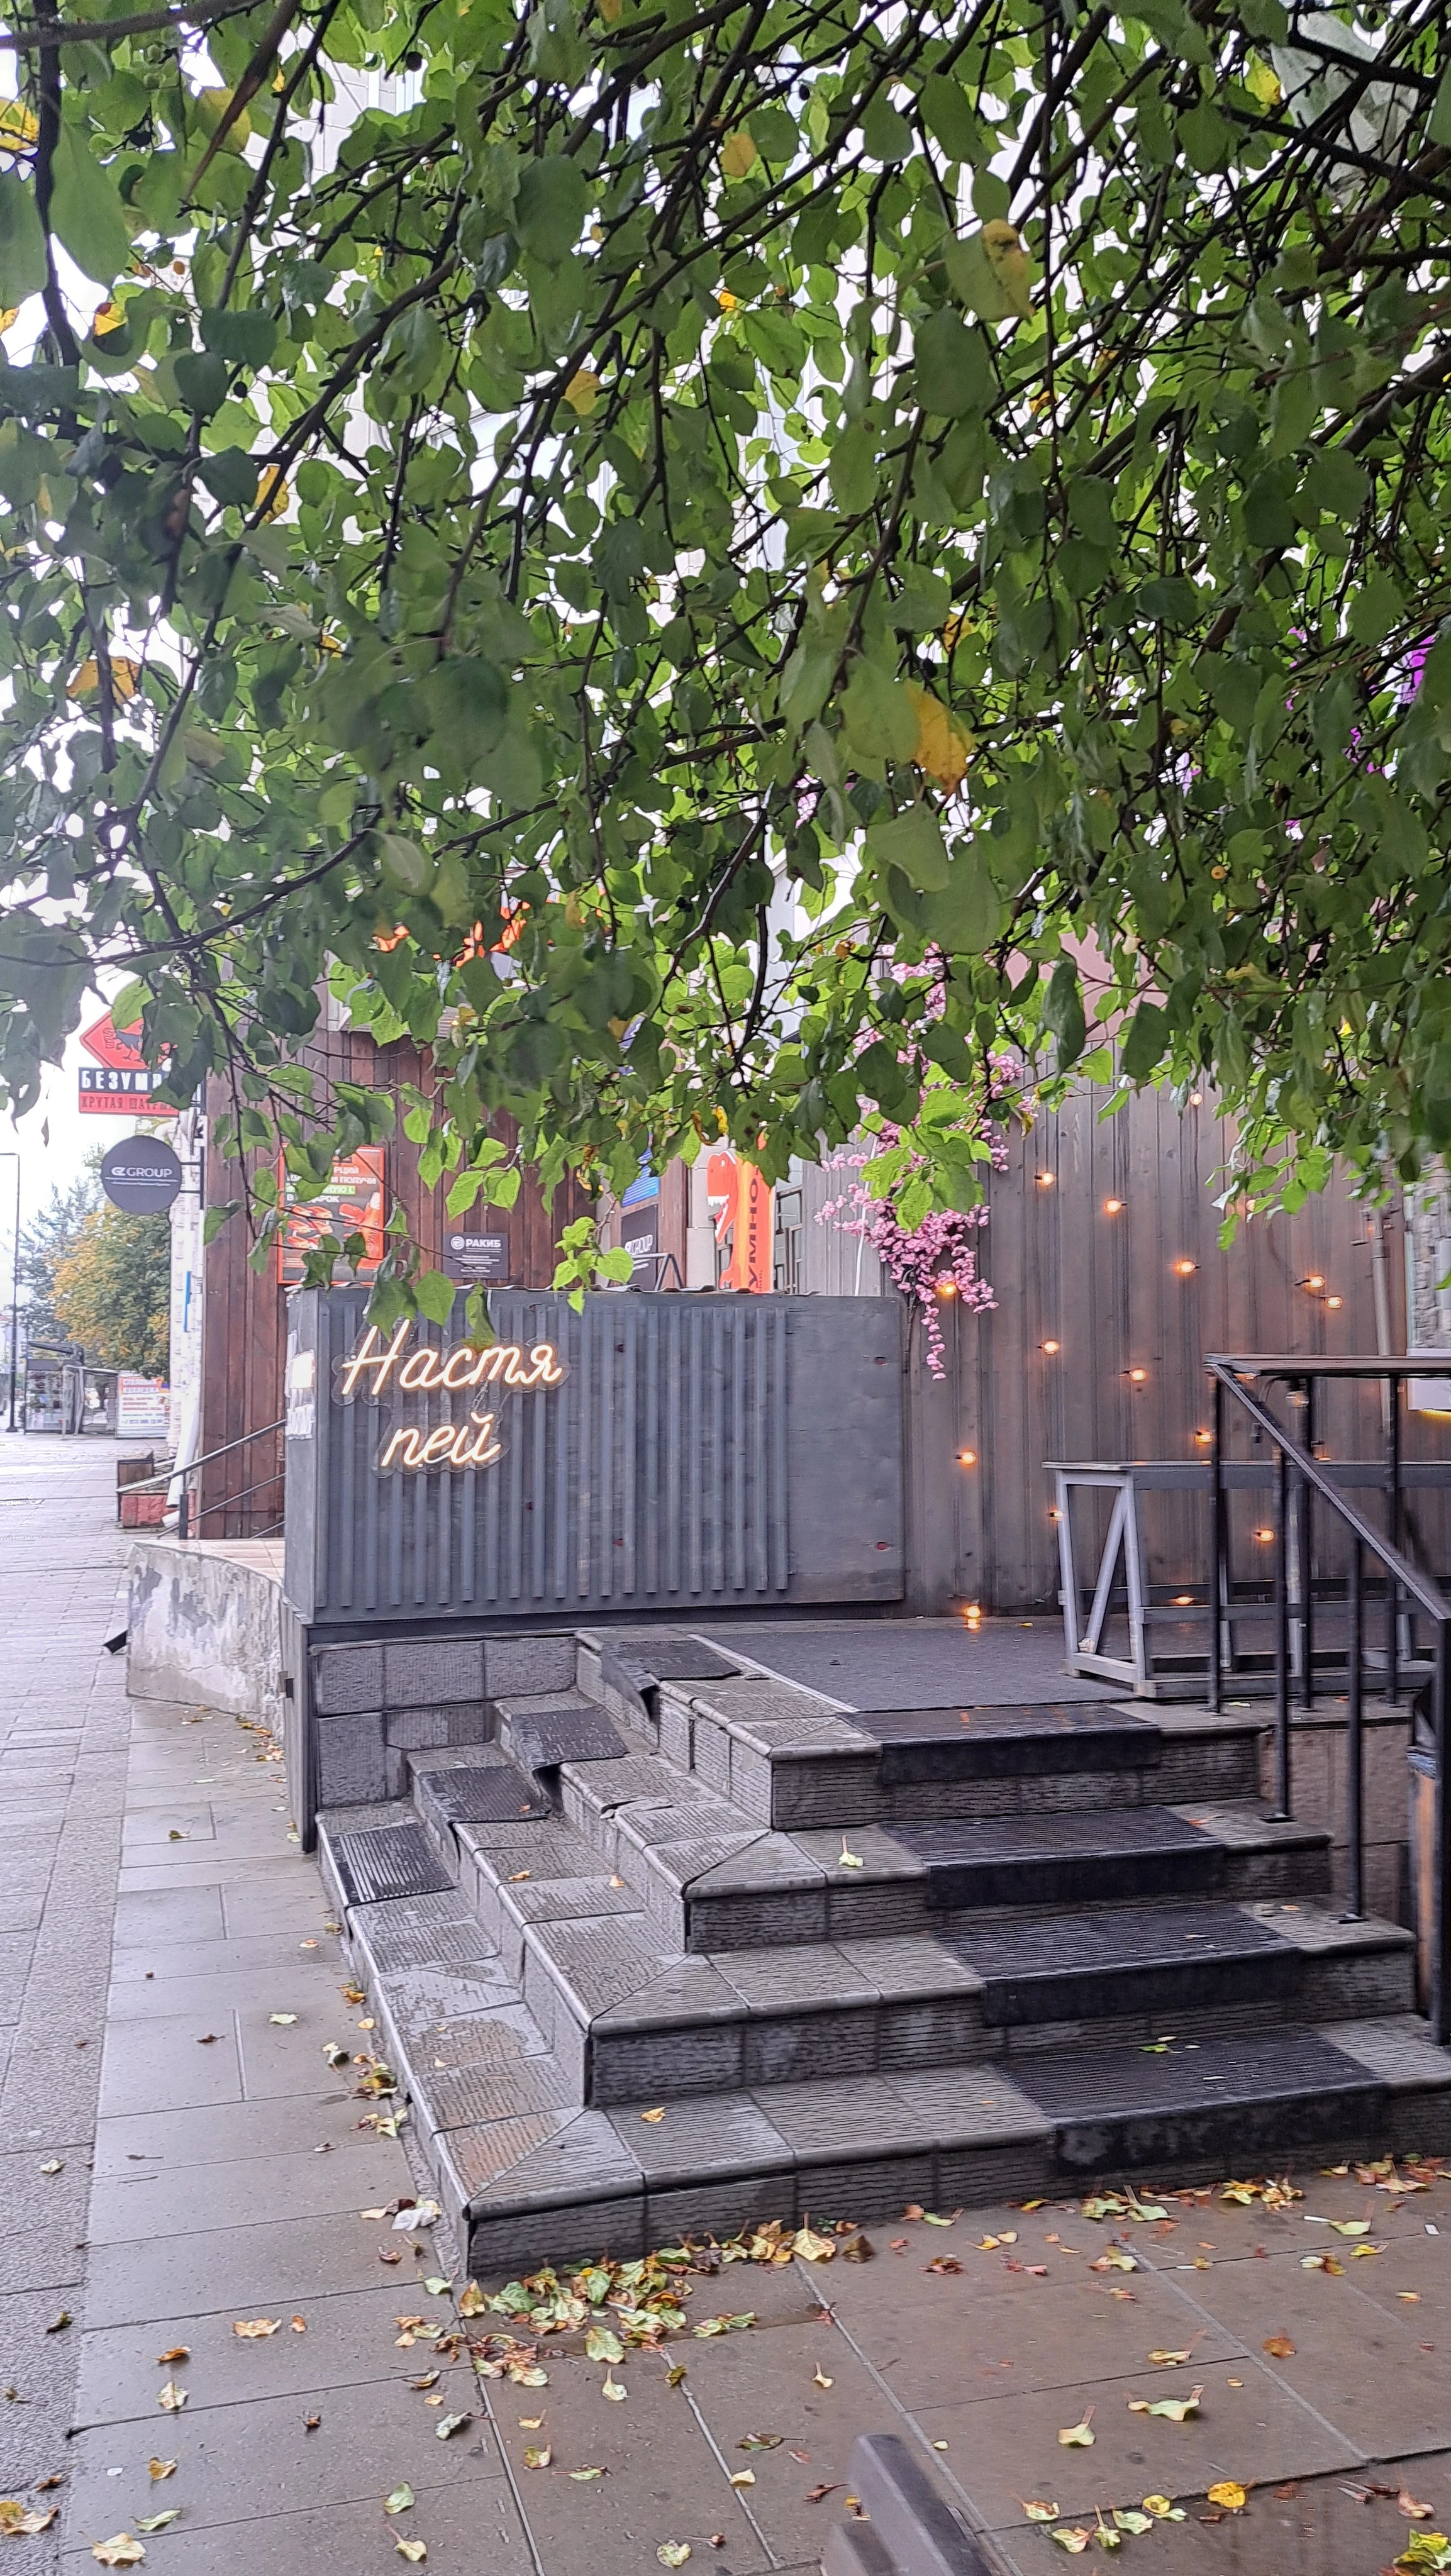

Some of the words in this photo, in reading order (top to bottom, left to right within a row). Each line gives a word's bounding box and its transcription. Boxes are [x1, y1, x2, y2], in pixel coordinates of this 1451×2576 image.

[465, 1238, 501, 1248] РАКИБ
[342, 1319, 563, 1396] Настя
[381, 1412, 501, 1467] пей
